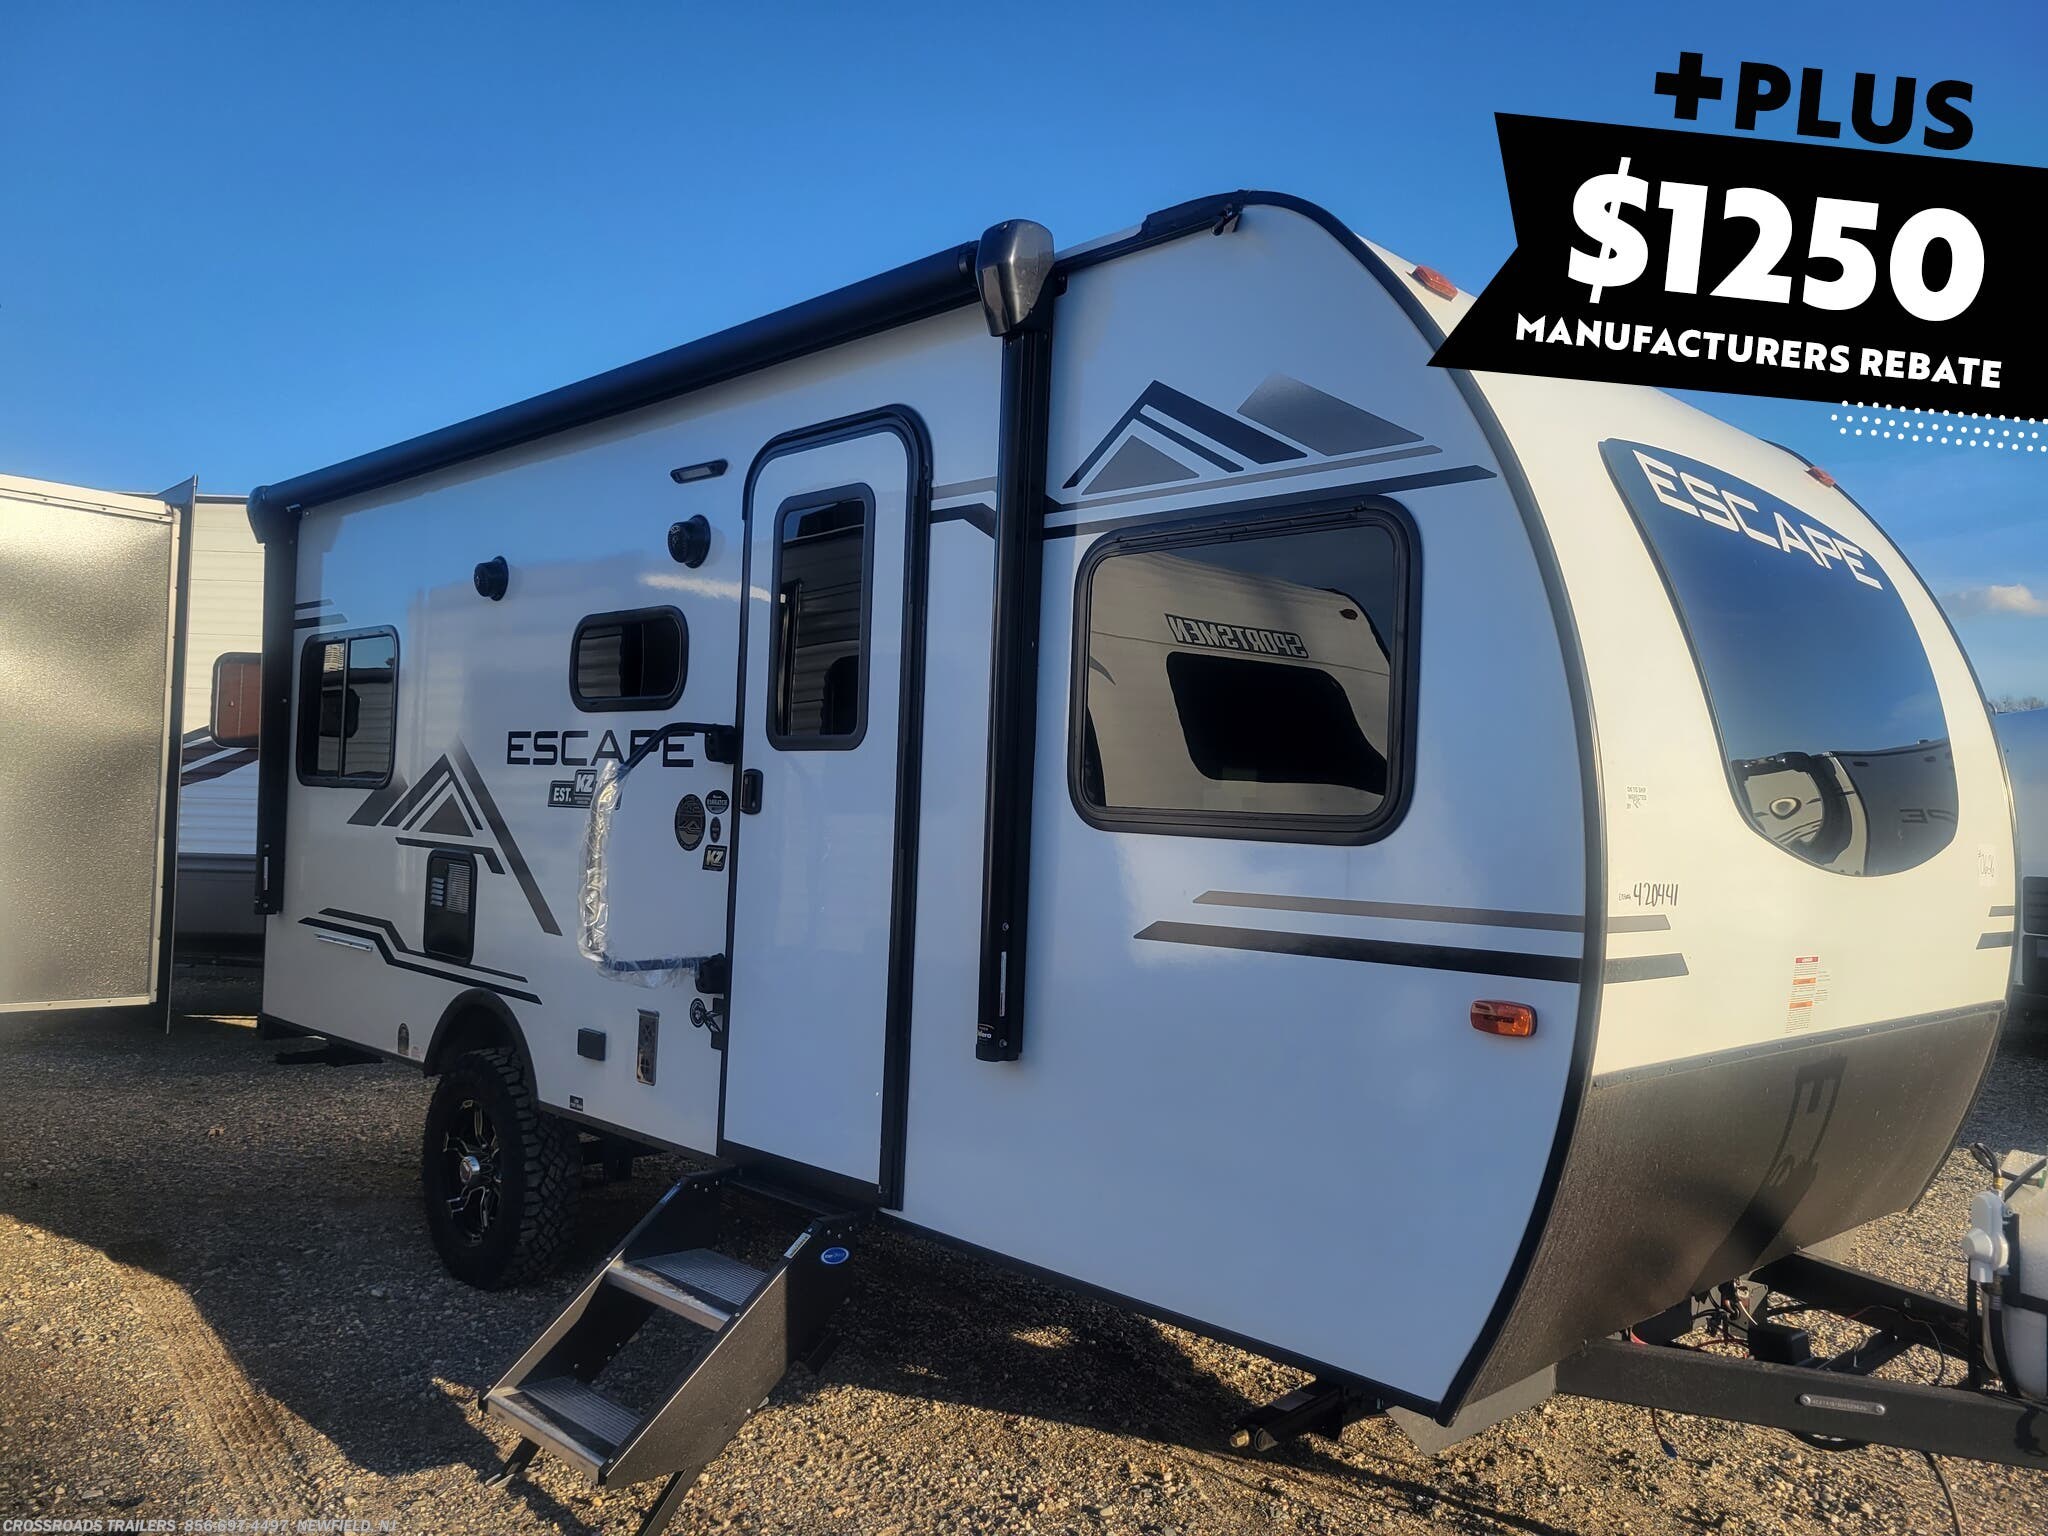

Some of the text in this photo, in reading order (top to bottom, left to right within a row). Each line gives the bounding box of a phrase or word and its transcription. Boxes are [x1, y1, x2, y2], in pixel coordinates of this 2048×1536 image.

[1632, 449, 1883, 590] ESCAPE
[507, 729, 696, 768] ESCAPE
[553, 787, 572, 802] EST.
[575, 774, 595, 793] KZ
[1633, 882, 1679, 907] 420441
